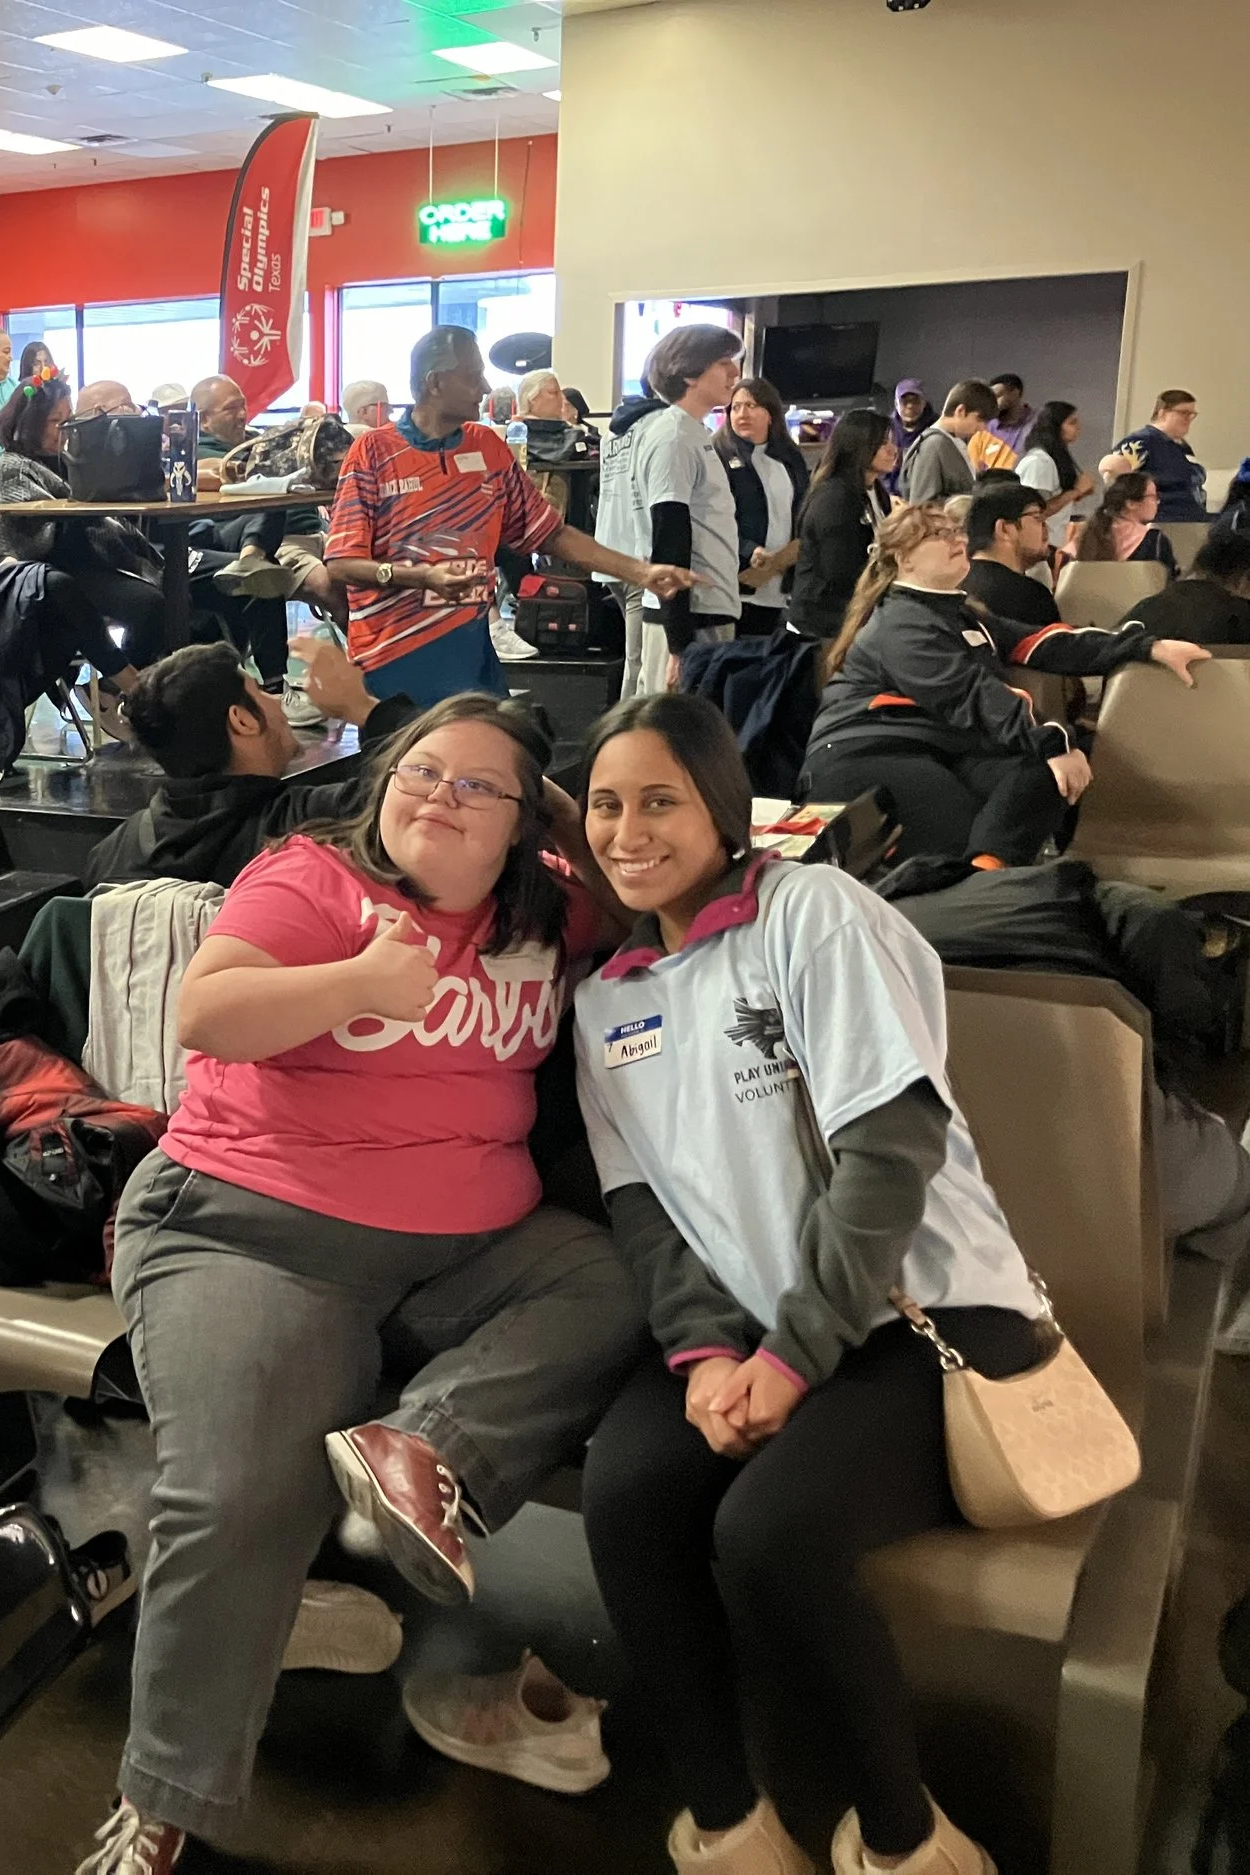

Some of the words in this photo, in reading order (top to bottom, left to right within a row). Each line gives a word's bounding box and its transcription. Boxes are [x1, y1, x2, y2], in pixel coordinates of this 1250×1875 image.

[419, 200, 505, 225] ORDER
[253, 186, 270, 292] Olympics
[429, 220, 492, 244] HERE
[238, 206, 253, 292] Special
[269, 253, 281, 292] Texas
[621, 1021, 645, 1034] HELLO
[621, 1035, 657, 1059] Abigail
[734, 1066, 760, 1084] PLAY
